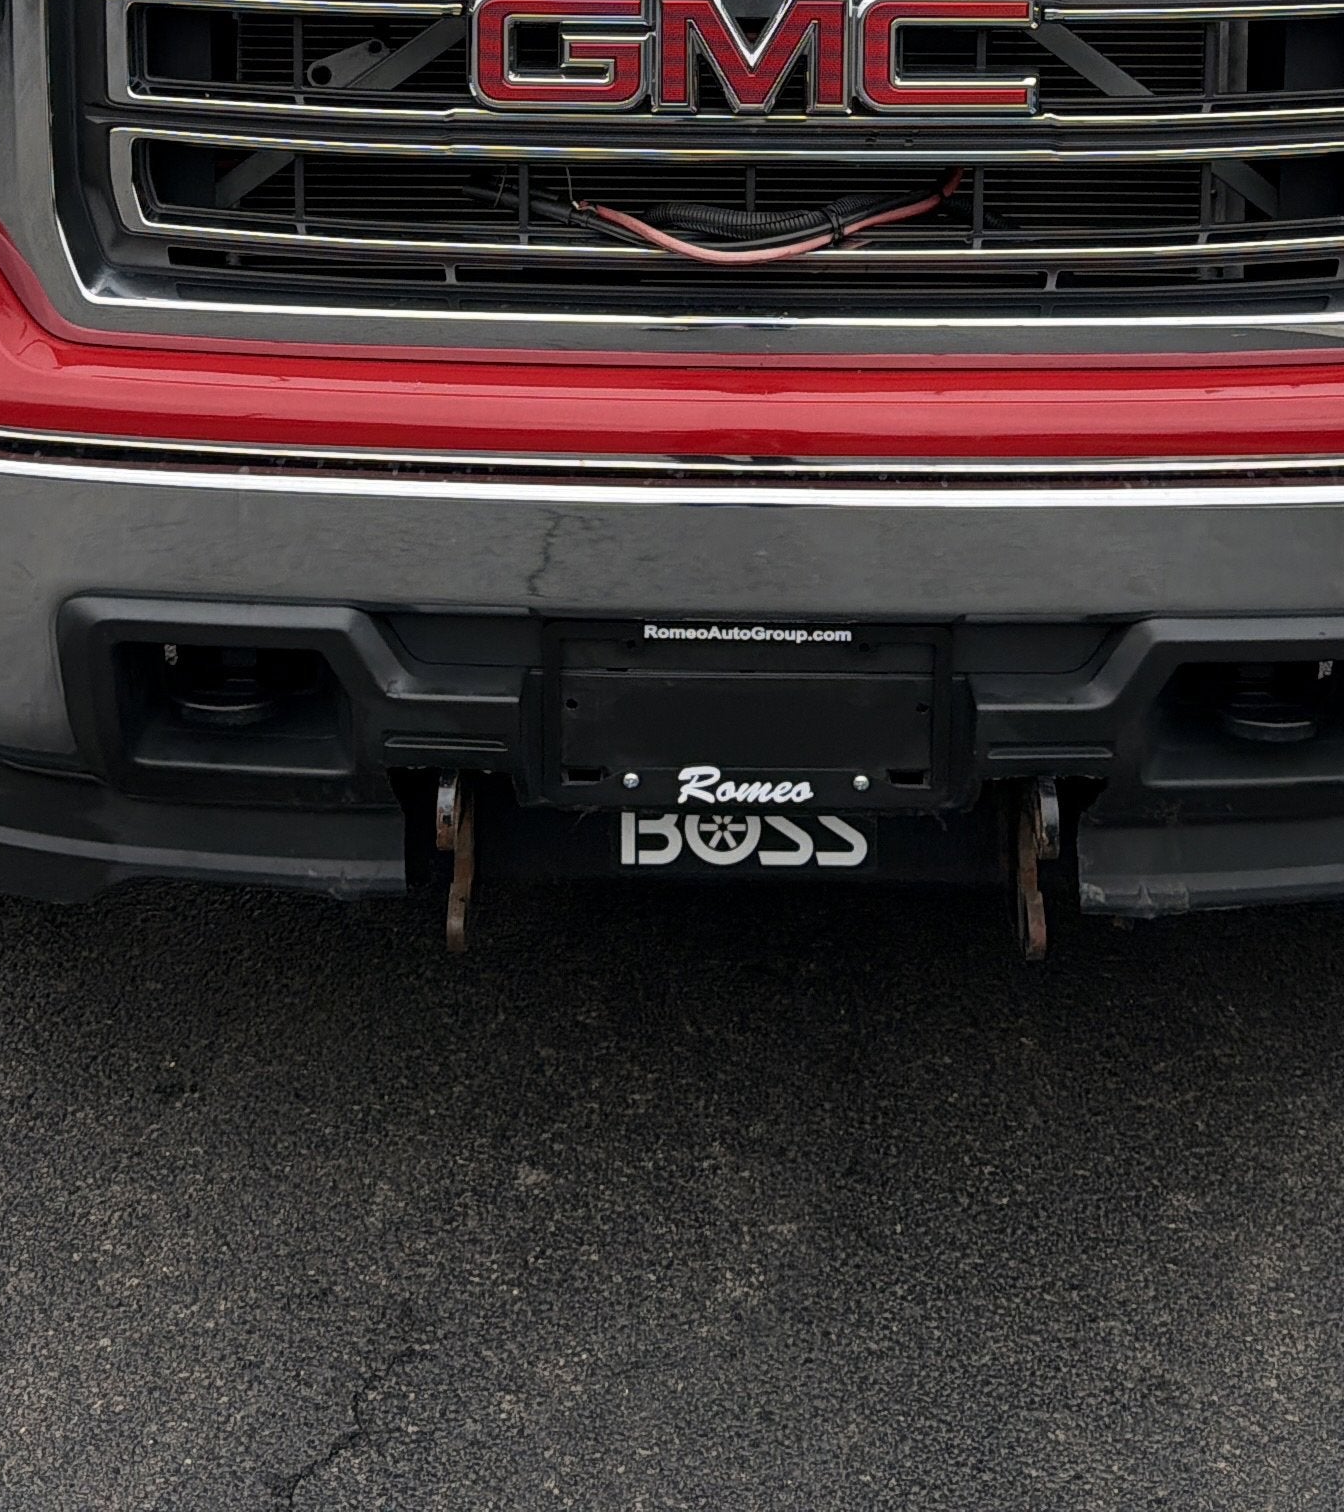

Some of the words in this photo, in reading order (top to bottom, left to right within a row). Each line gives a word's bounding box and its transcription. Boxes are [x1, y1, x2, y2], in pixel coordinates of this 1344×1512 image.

[644, 625, 852, 643] RomeoAutoGroup.com
[677, 765, 814, 803] Romeo
[621, 811, 868, 866] BOSS
